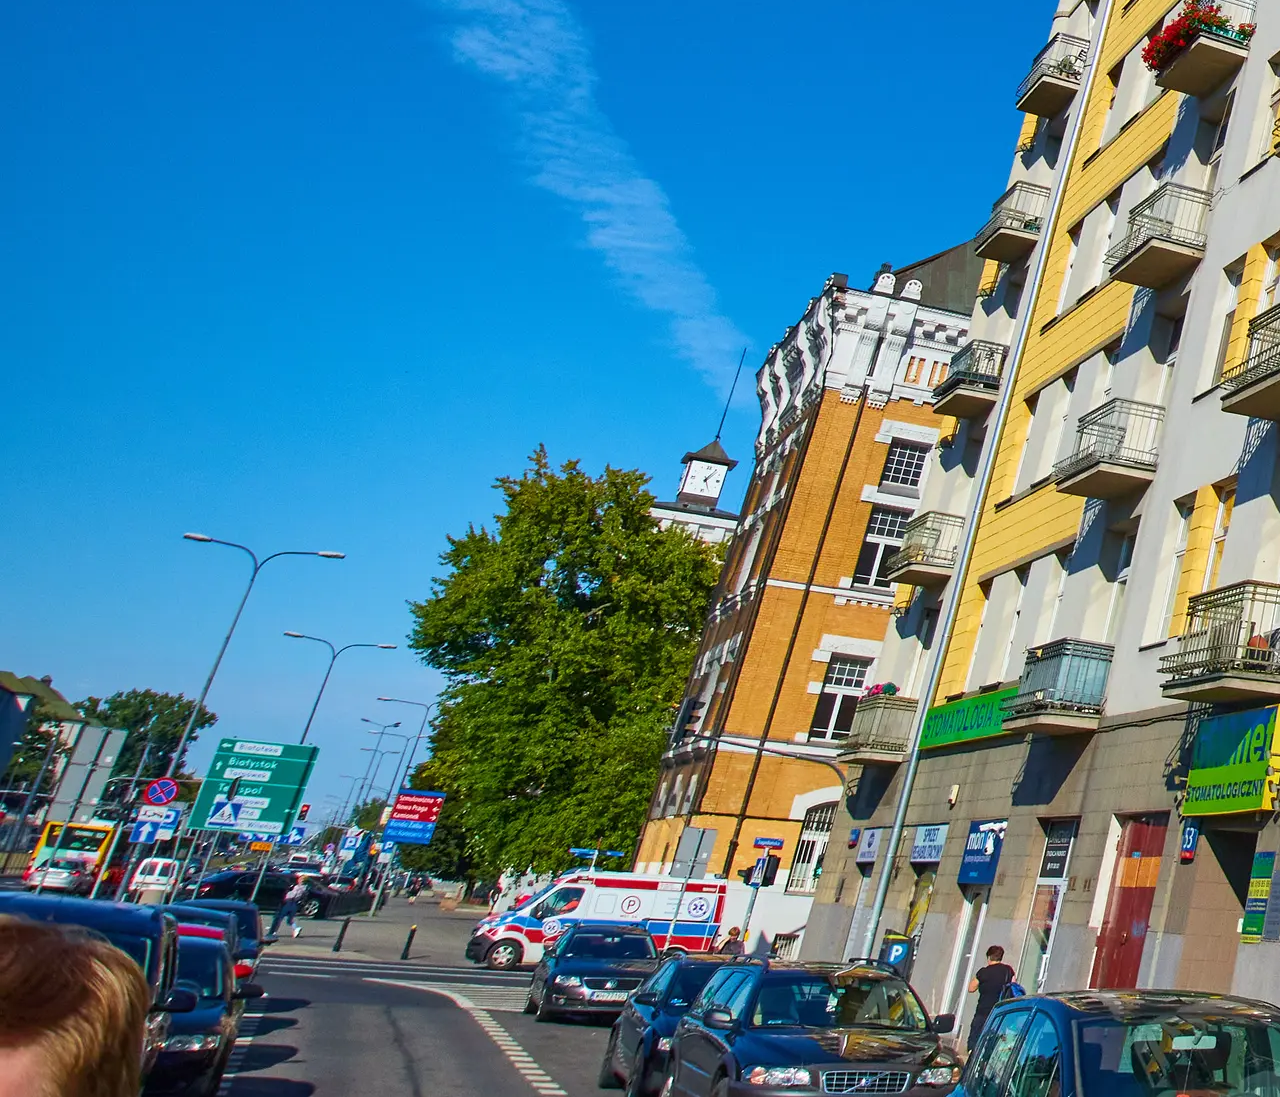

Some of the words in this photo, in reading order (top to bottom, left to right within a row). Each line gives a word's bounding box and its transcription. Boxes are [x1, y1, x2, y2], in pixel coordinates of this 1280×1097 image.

[924, 702, 994, 739] STOMATOLOGIA
[218, 782, 263, 795] Tespol
[1185, 778, 1266, 803] STOMATOLOGICZNY
[1183, 827, 1196, 849] 53
